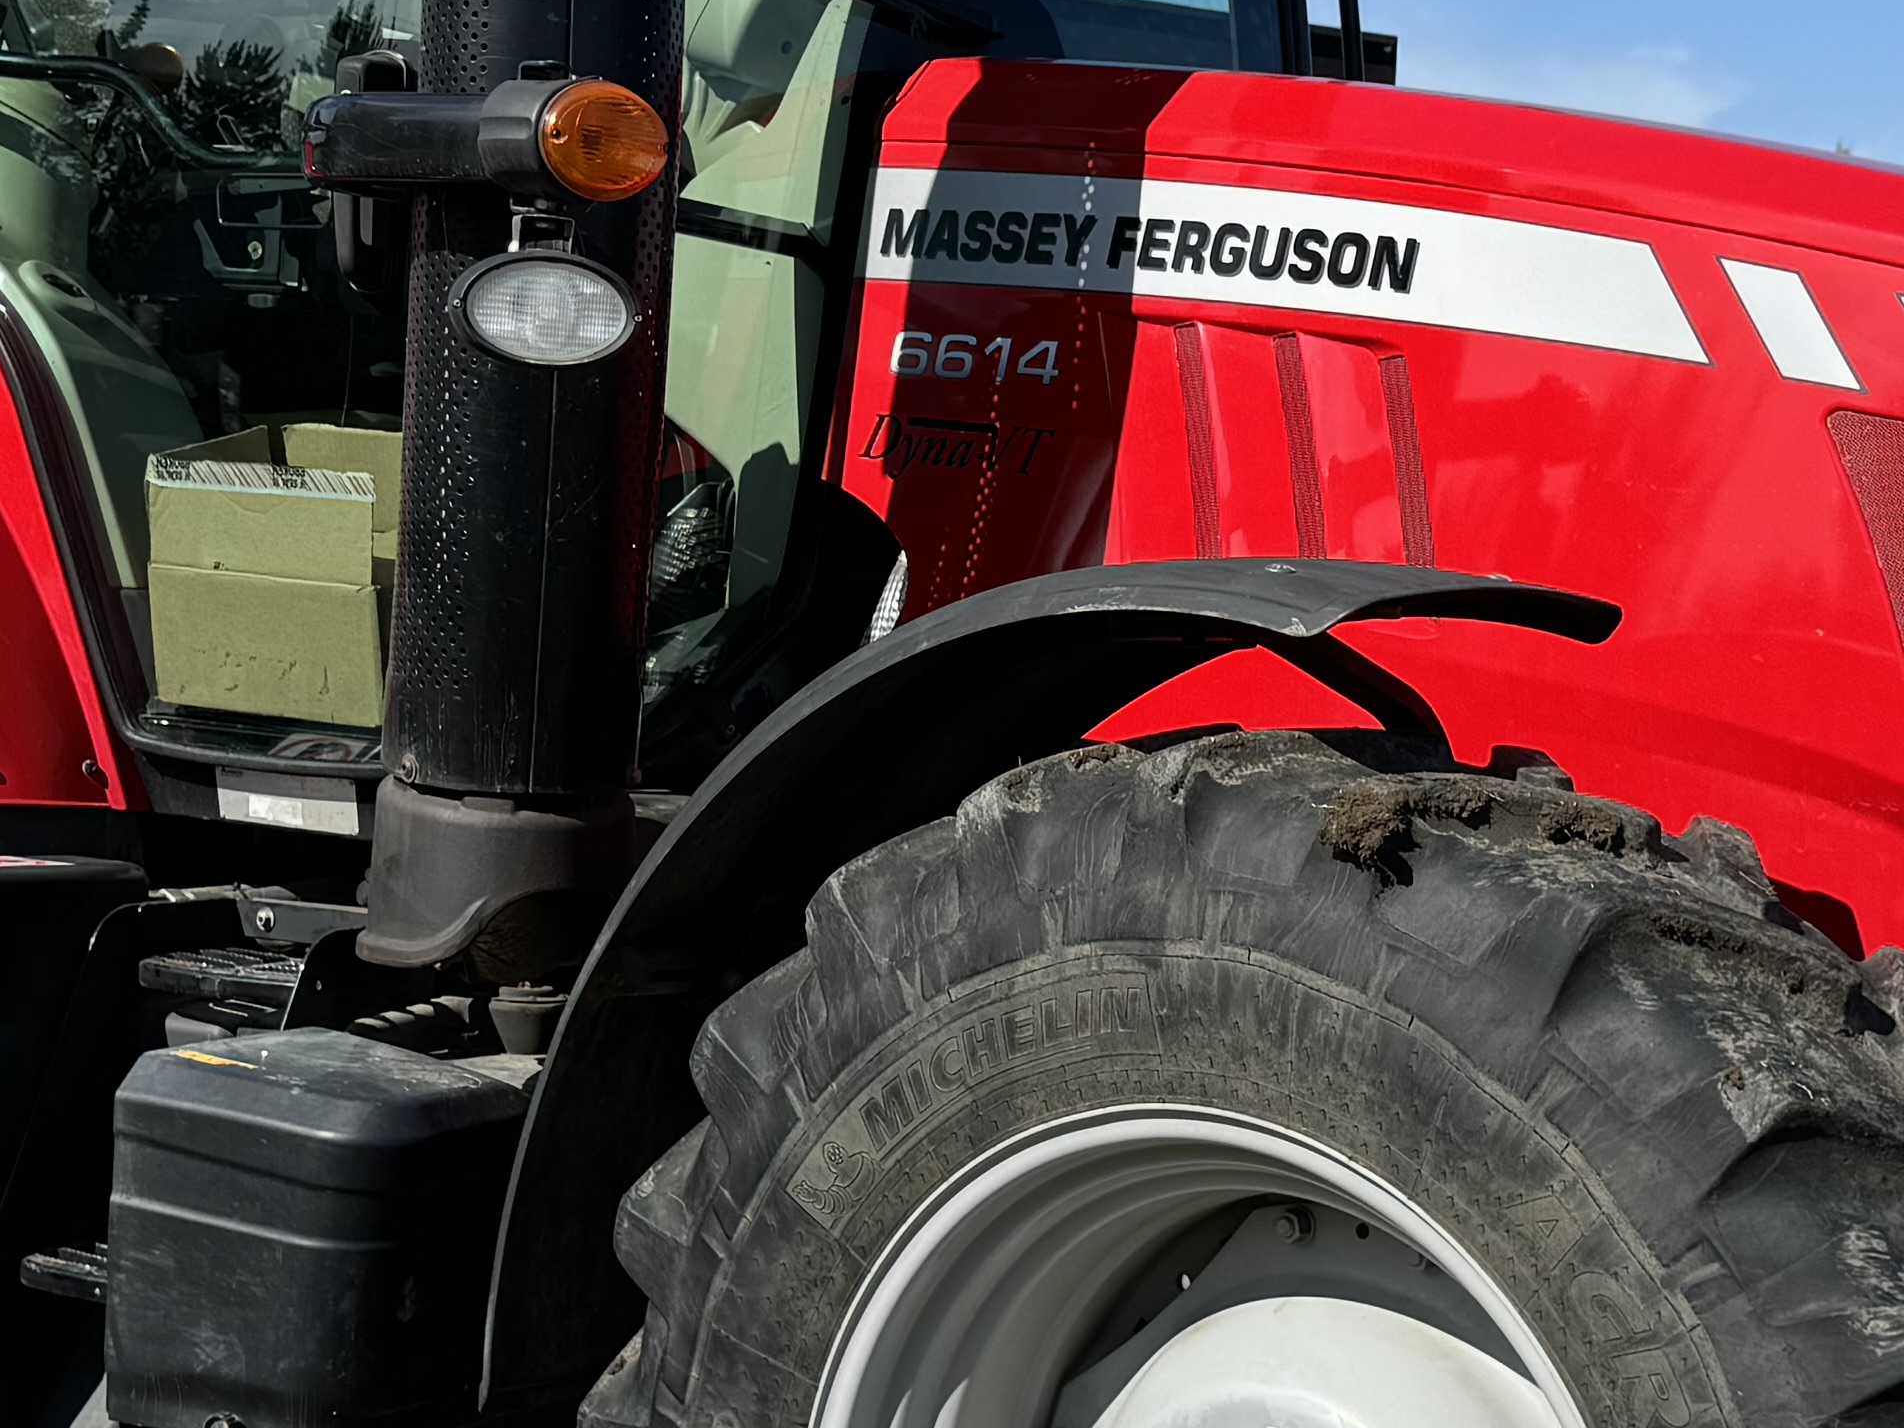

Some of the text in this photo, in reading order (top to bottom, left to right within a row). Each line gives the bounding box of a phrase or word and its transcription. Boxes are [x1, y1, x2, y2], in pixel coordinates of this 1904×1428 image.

[880, 208, 1421, 294] MASSEY FERGUSON
[890, 331, 1059, 384] 6614
[858, 413, 1056, 480] Dyna-VT
[858, 987, 1144, 1153] MICHELIN
